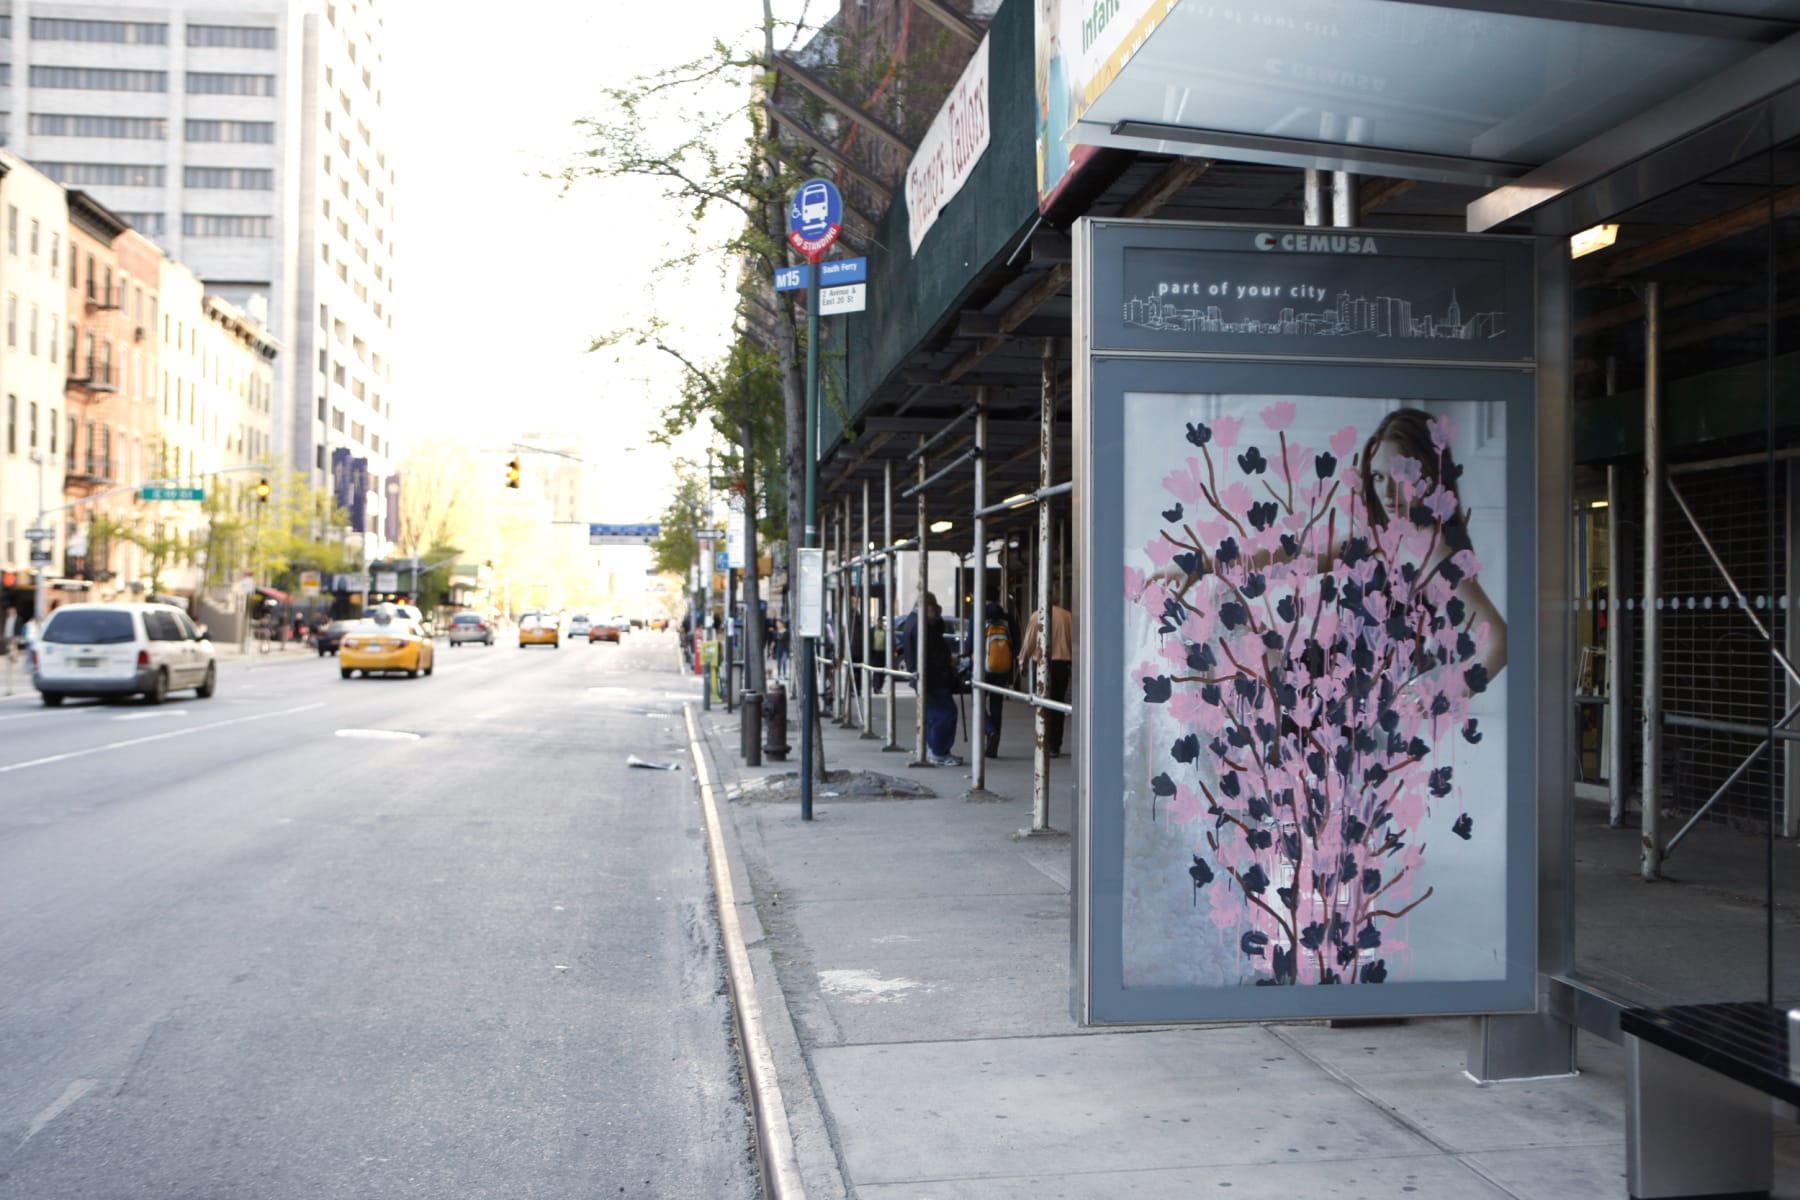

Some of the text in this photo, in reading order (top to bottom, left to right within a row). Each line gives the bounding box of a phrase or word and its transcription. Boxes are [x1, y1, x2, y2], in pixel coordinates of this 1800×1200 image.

[948, 78, 986, 181] Tailors
[793, 226, 838, 250] NO STANDING
[1281, 233, 1378, 254] CEMUSA
[822, 262, 857, 274] South Ferry
[776, 270, 800, 289] M15
[1158, 281, 1326, 301] part of your city
